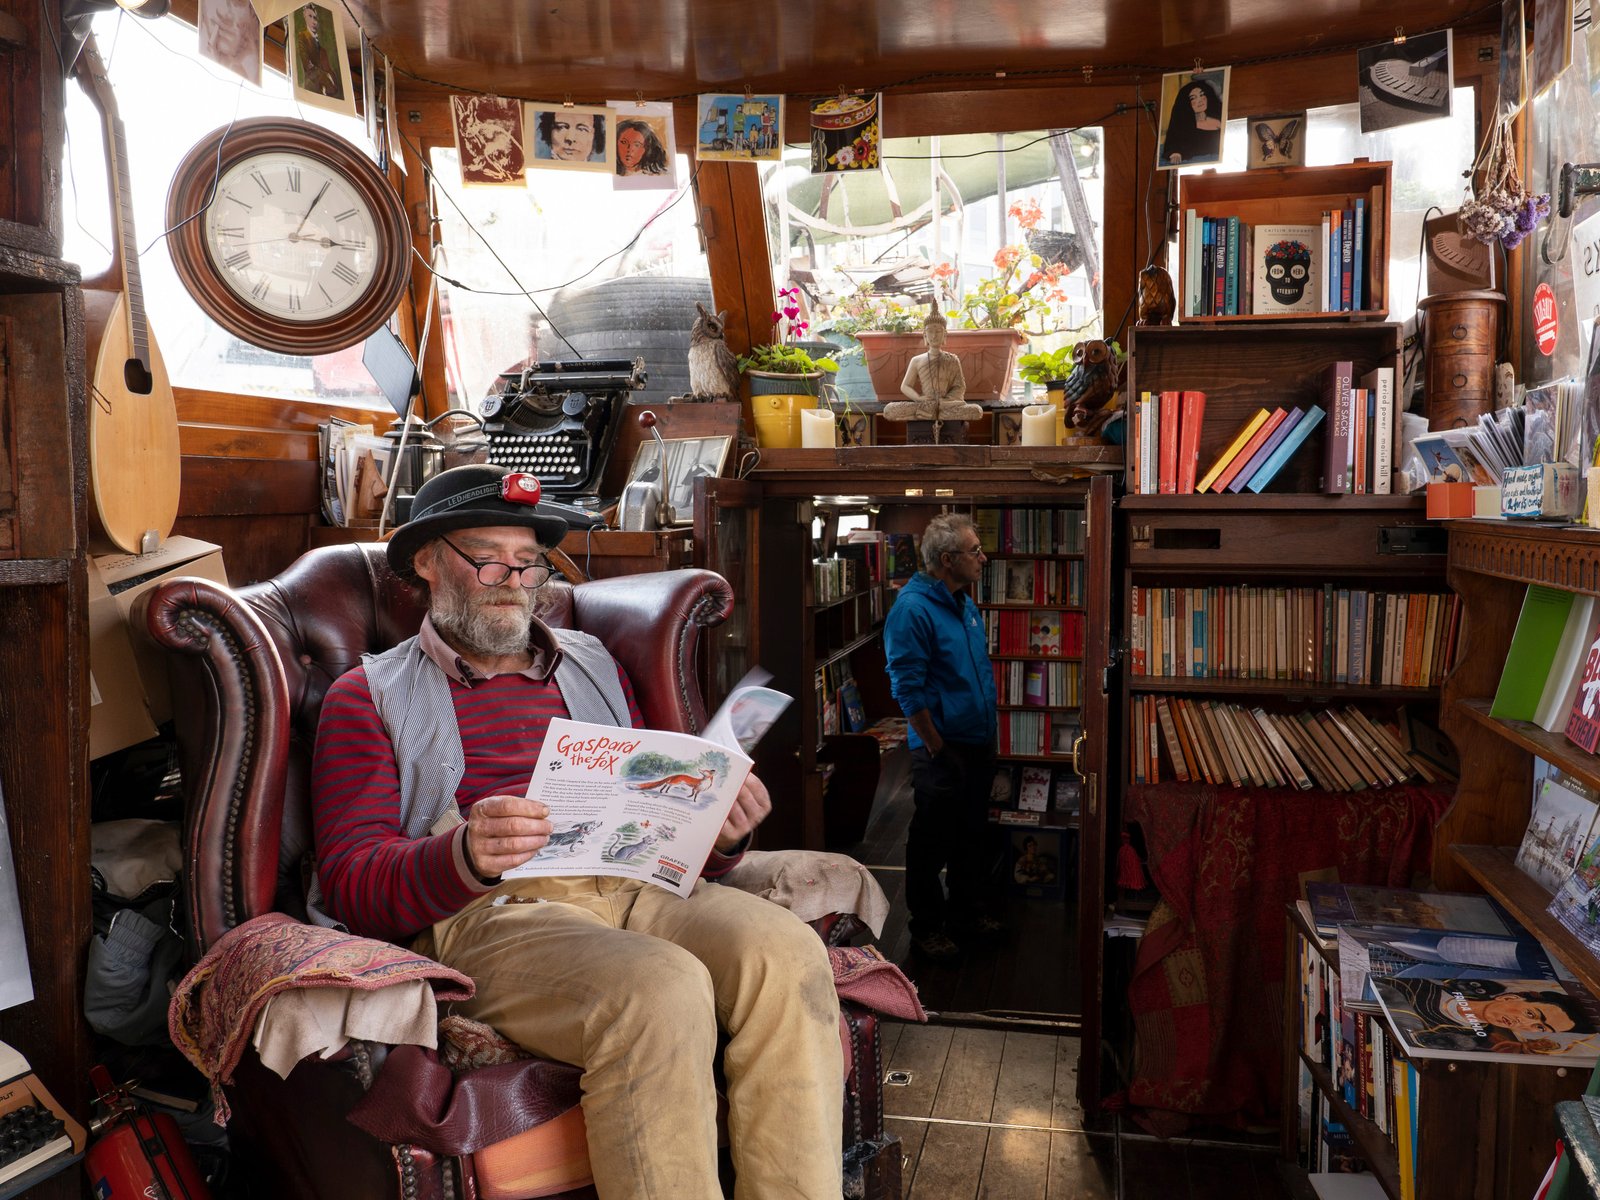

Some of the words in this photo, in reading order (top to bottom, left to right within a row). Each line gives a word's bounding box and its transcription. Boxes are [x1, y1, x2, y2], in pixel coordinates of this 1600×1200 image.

[1341, 377, 1350, 406] OLIVER
[1382, 379, 1390, 404] period
[1340, 410, 1349, 437] SACKS
[1379, 465, 1387, 477] hill
[448, 496, 462, 506] LED
[462, 486, 498, 500] HEADLIGHT
[557, 734, 641, 757] Gaspard
[570, 753, 592, 766] the
[587, 751, 619, 775] fox
[1451, 991, 1472, 1012] FRIDA
[1464, 1013, 1487, 1037] KAHLO
